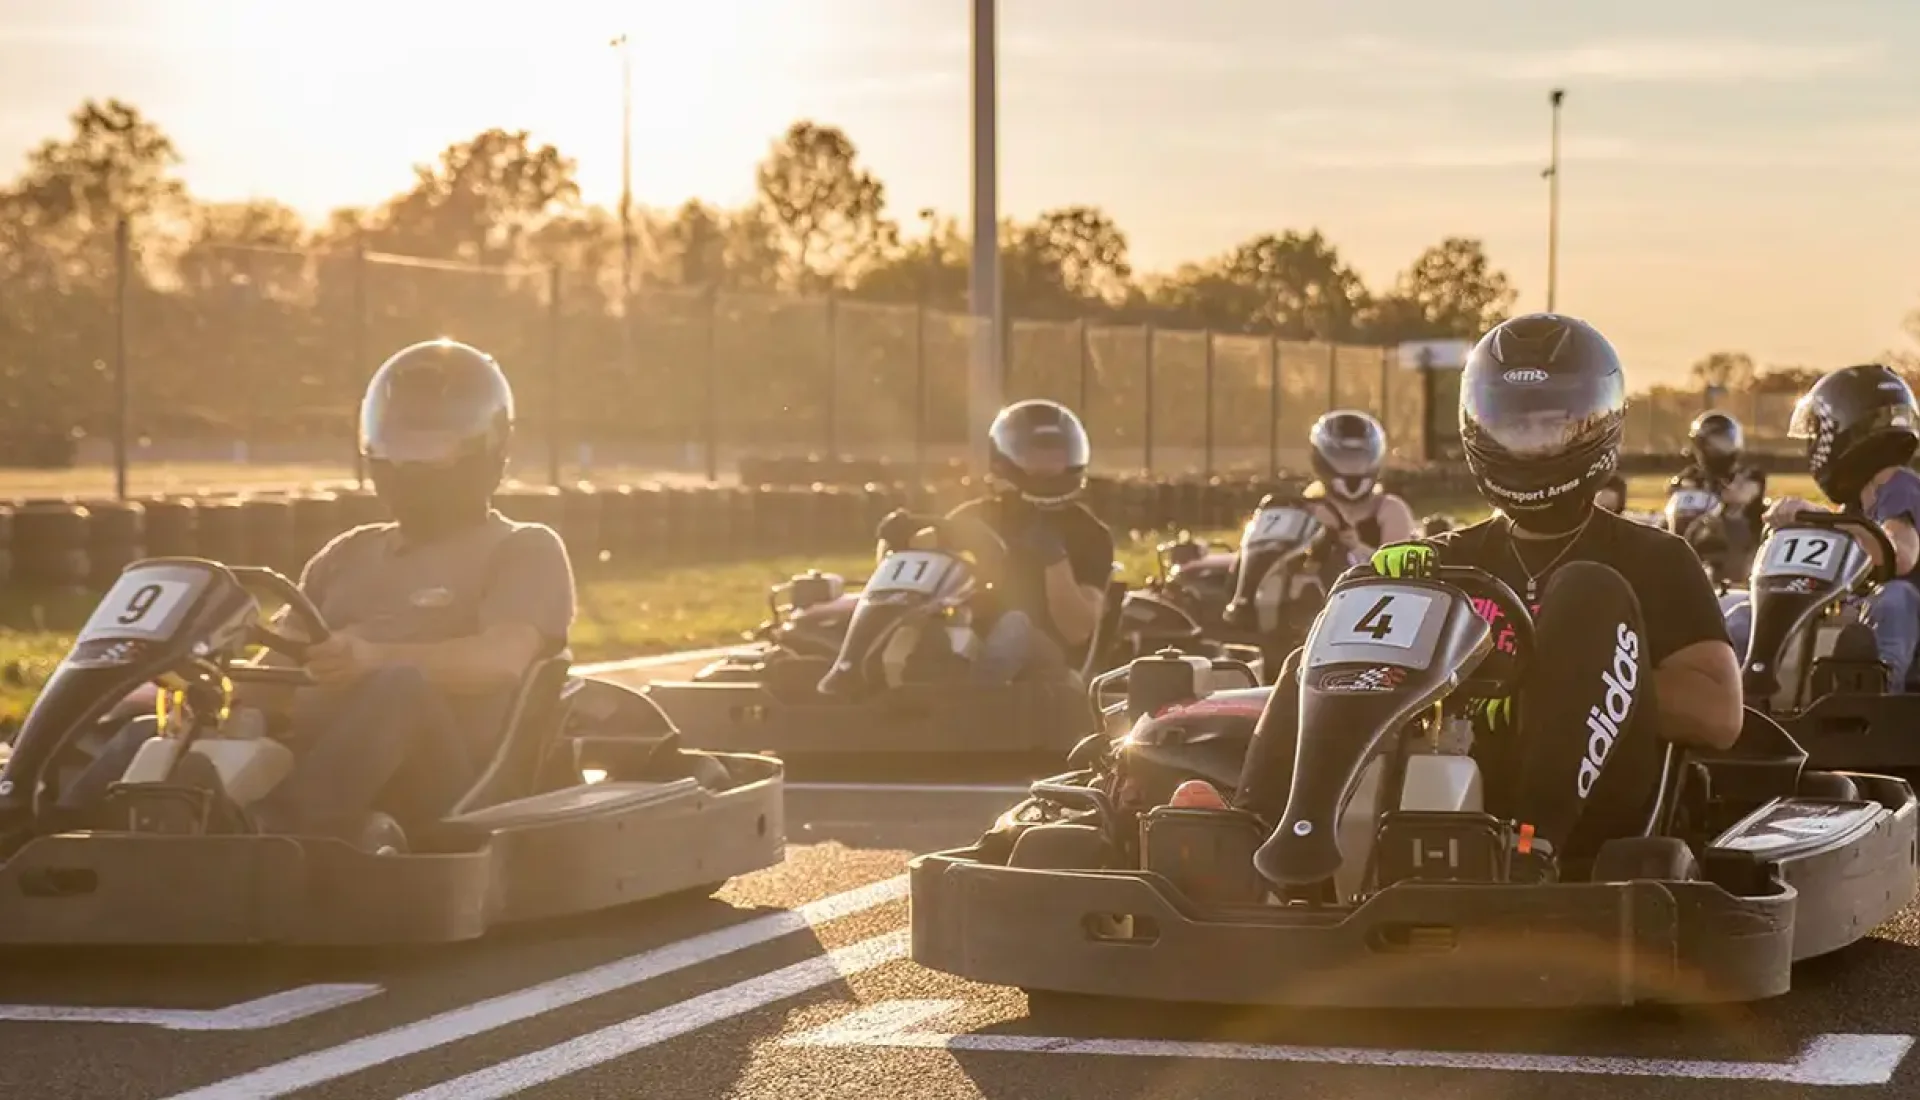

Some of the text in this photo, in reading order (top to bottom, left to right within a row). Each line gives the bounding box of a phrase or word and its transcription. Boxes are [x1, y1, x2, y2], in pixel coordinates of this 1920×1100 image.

[891, 560, 929, 581] 11
[1783, 538, 1829, 567] 12
[117, 584, 163, 625] 9
[1353, 595, 1395, 640] 4
[1577, 622, 1639, 799] adidas
